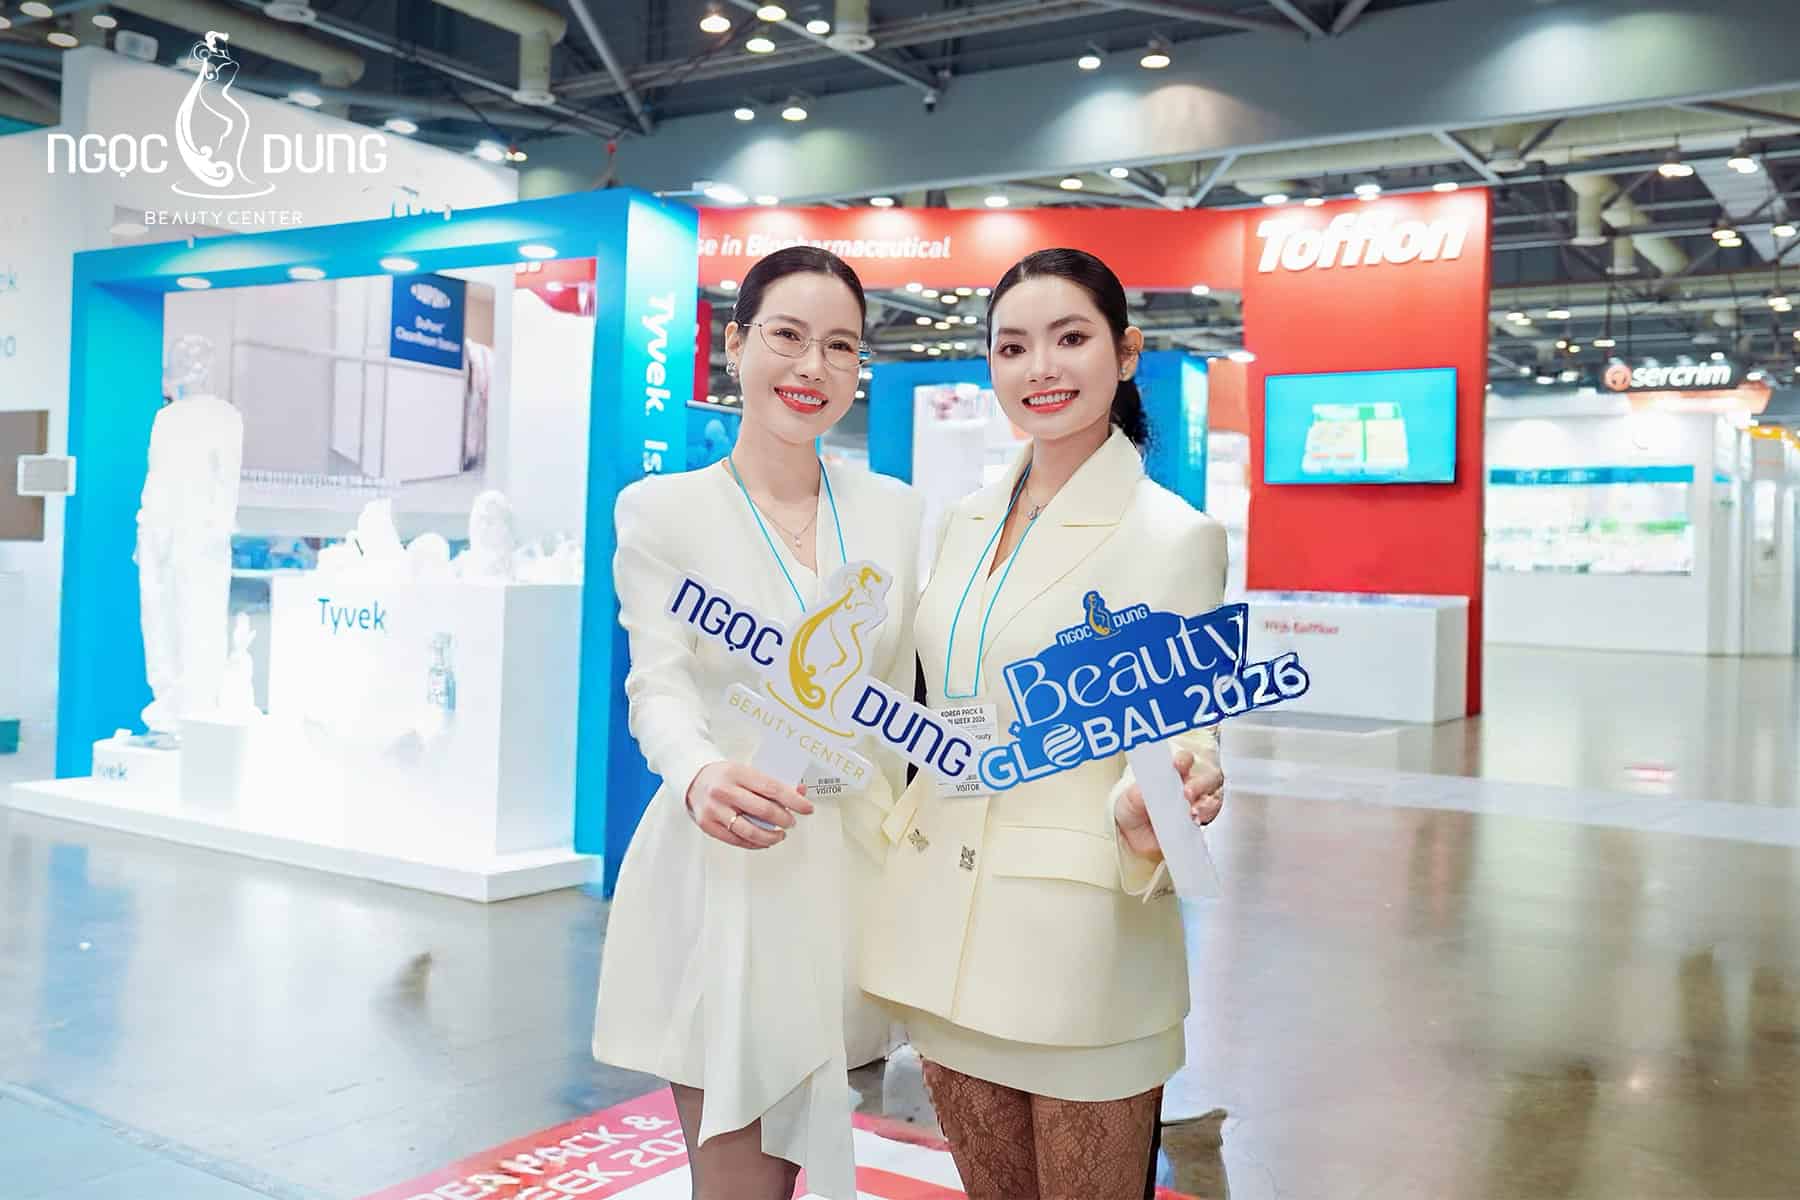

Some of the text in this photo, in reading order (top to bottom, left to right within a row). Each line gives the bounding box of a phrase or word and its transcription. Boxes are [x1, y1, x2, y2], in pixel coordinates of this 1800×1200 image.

[722, 233, 742, 257] in
[1256, 211, 1470, 273] Tofflon
[642, 292, 677, 413] Tyvek
[317, 597, 386, 635] Tyvek
[1112, 606, 1148, 628] DUNG
[671, 577, 972, 778] NGỌC DUNG
[1006, 611, 1244, 728] Beauty
[1184, 653, 1308, 726] 2026
[961, 707, 978, 717] PACK
[729, 693, 865, 780] BEAUTY CENTER
[816, 784, 842, 794] VISITOR
[621, 1114, 674, 1131] &
[609, 1129, 688, 1167] 20
